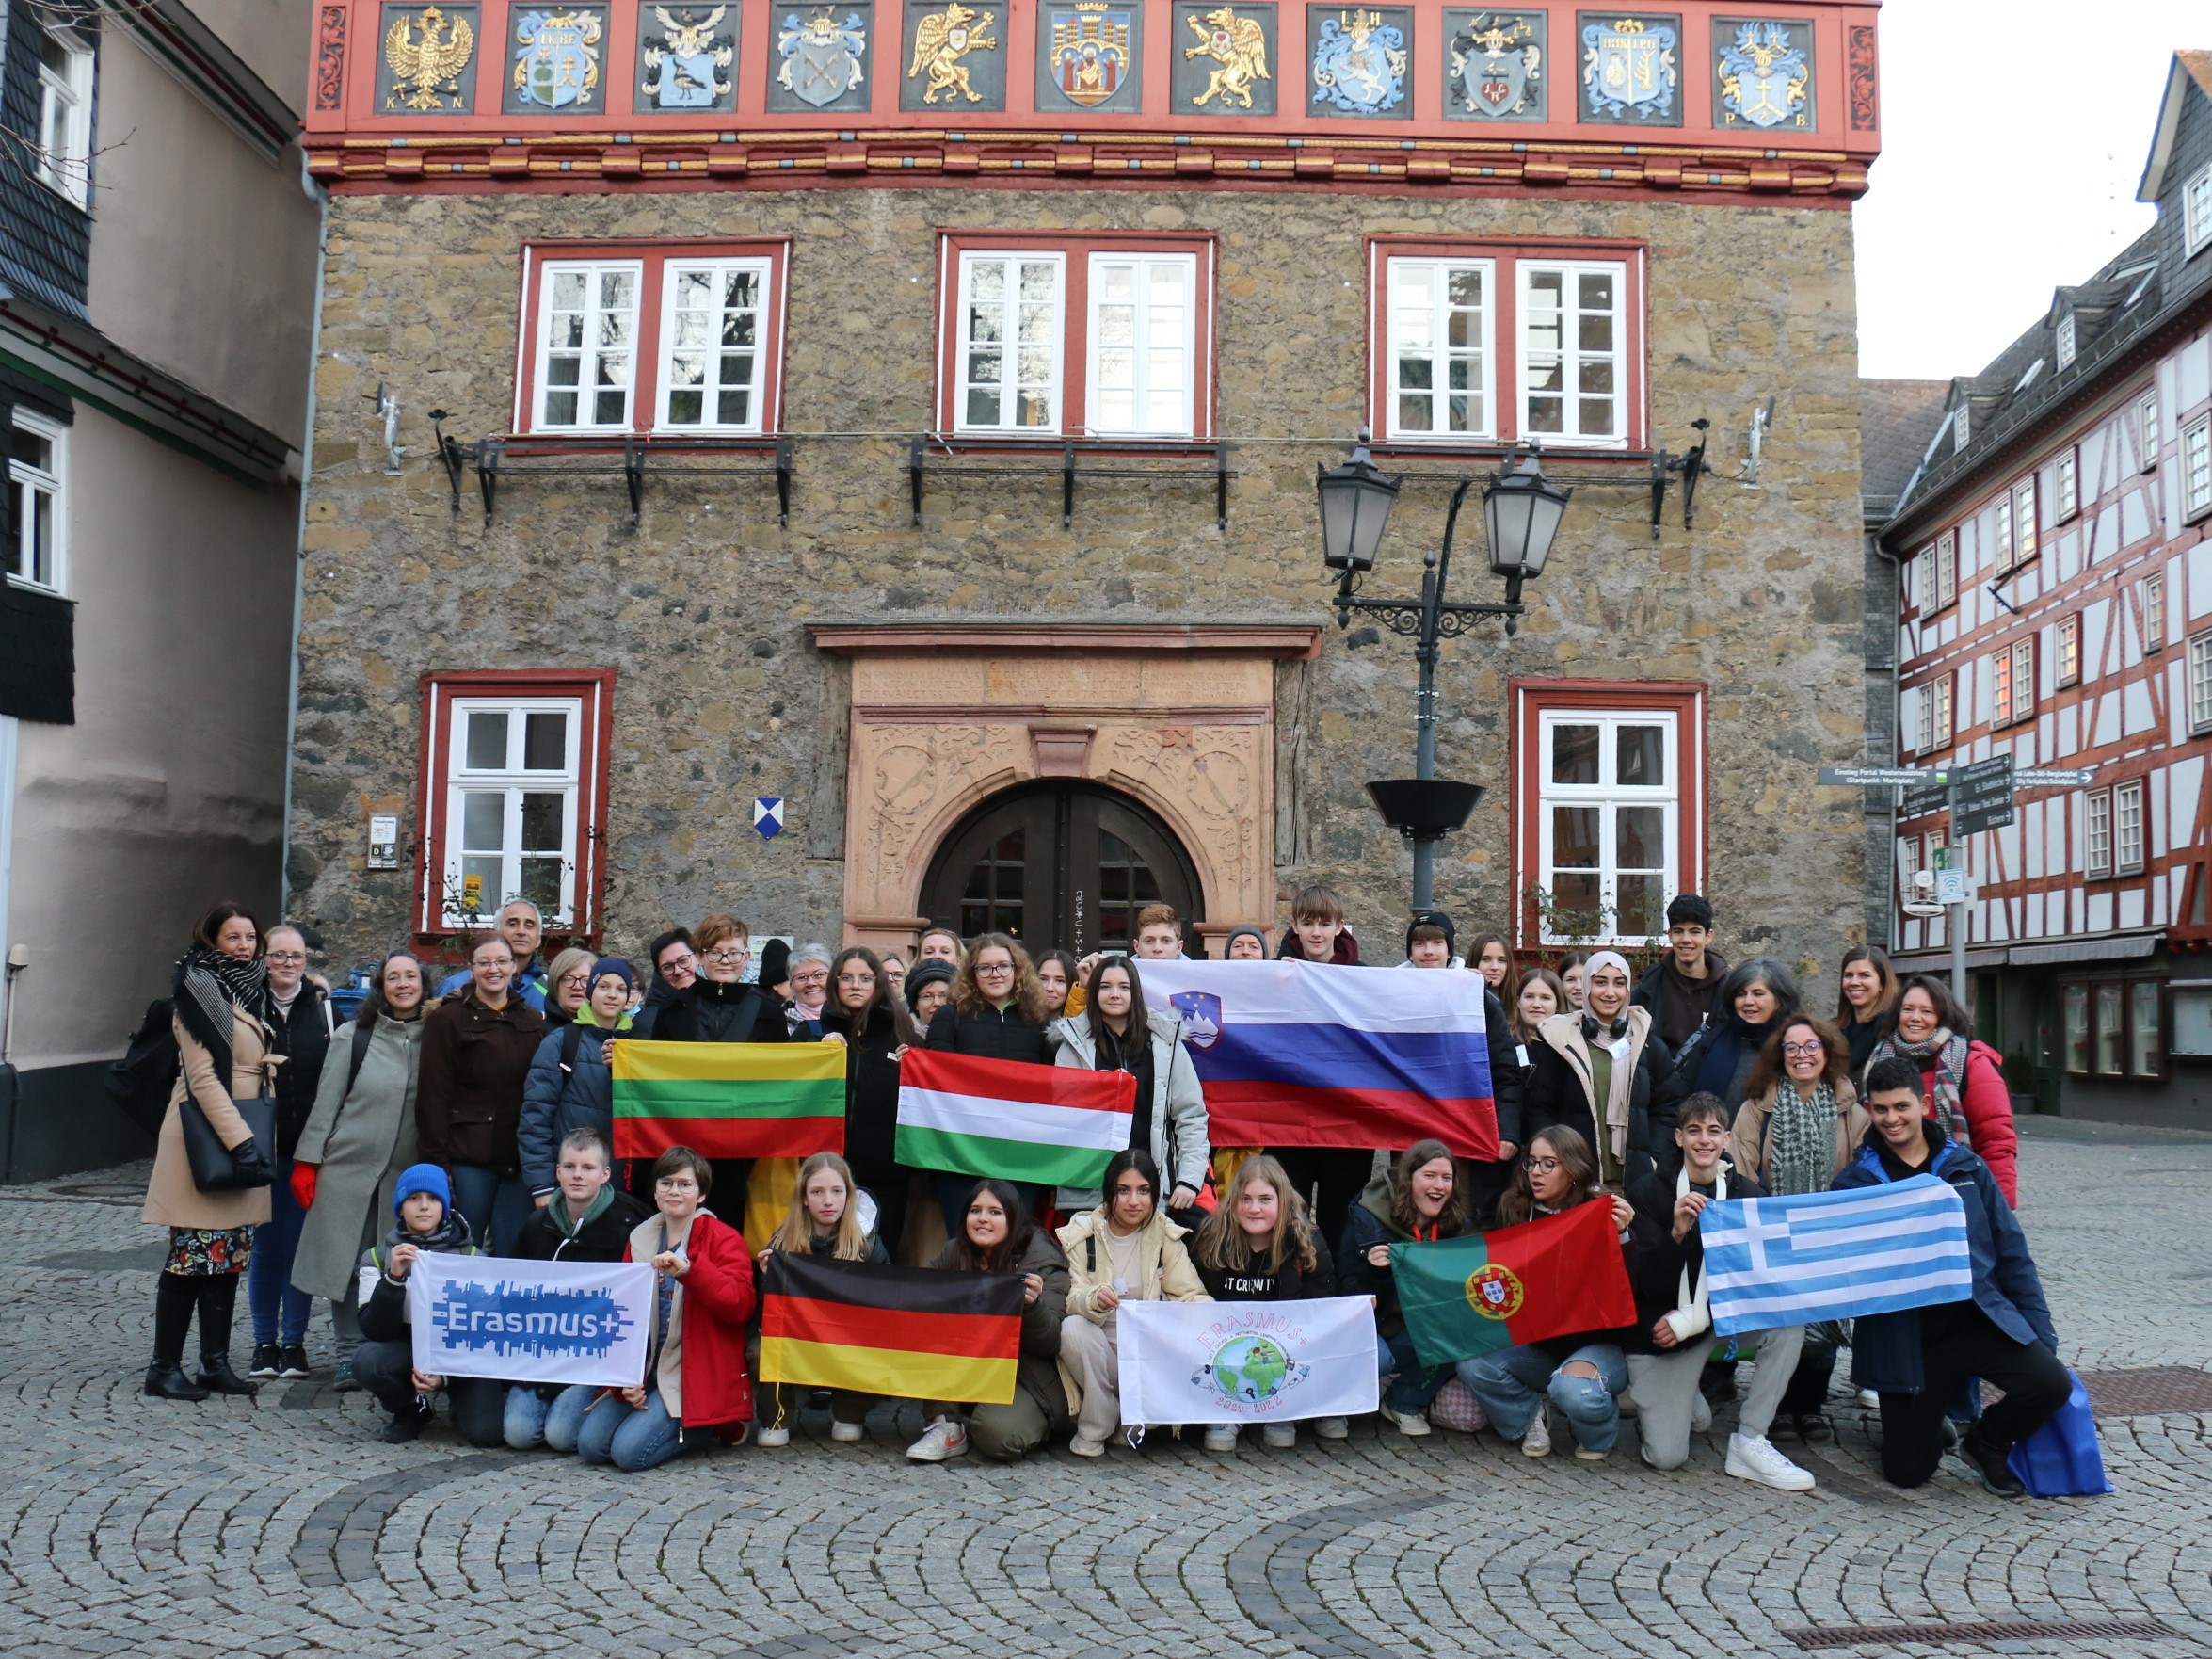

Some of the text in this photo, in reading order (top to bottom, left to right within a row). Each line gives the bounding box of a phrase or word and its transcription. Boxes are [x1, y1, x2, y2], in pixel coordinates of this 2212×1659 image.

[1835, 768, 1928, 779] Einstieg Portal Westerwaldsteig
[448, 1301, 619, 1338] Erasmus+
[1197, 1311, 1309, 1349] ERASMUS+
